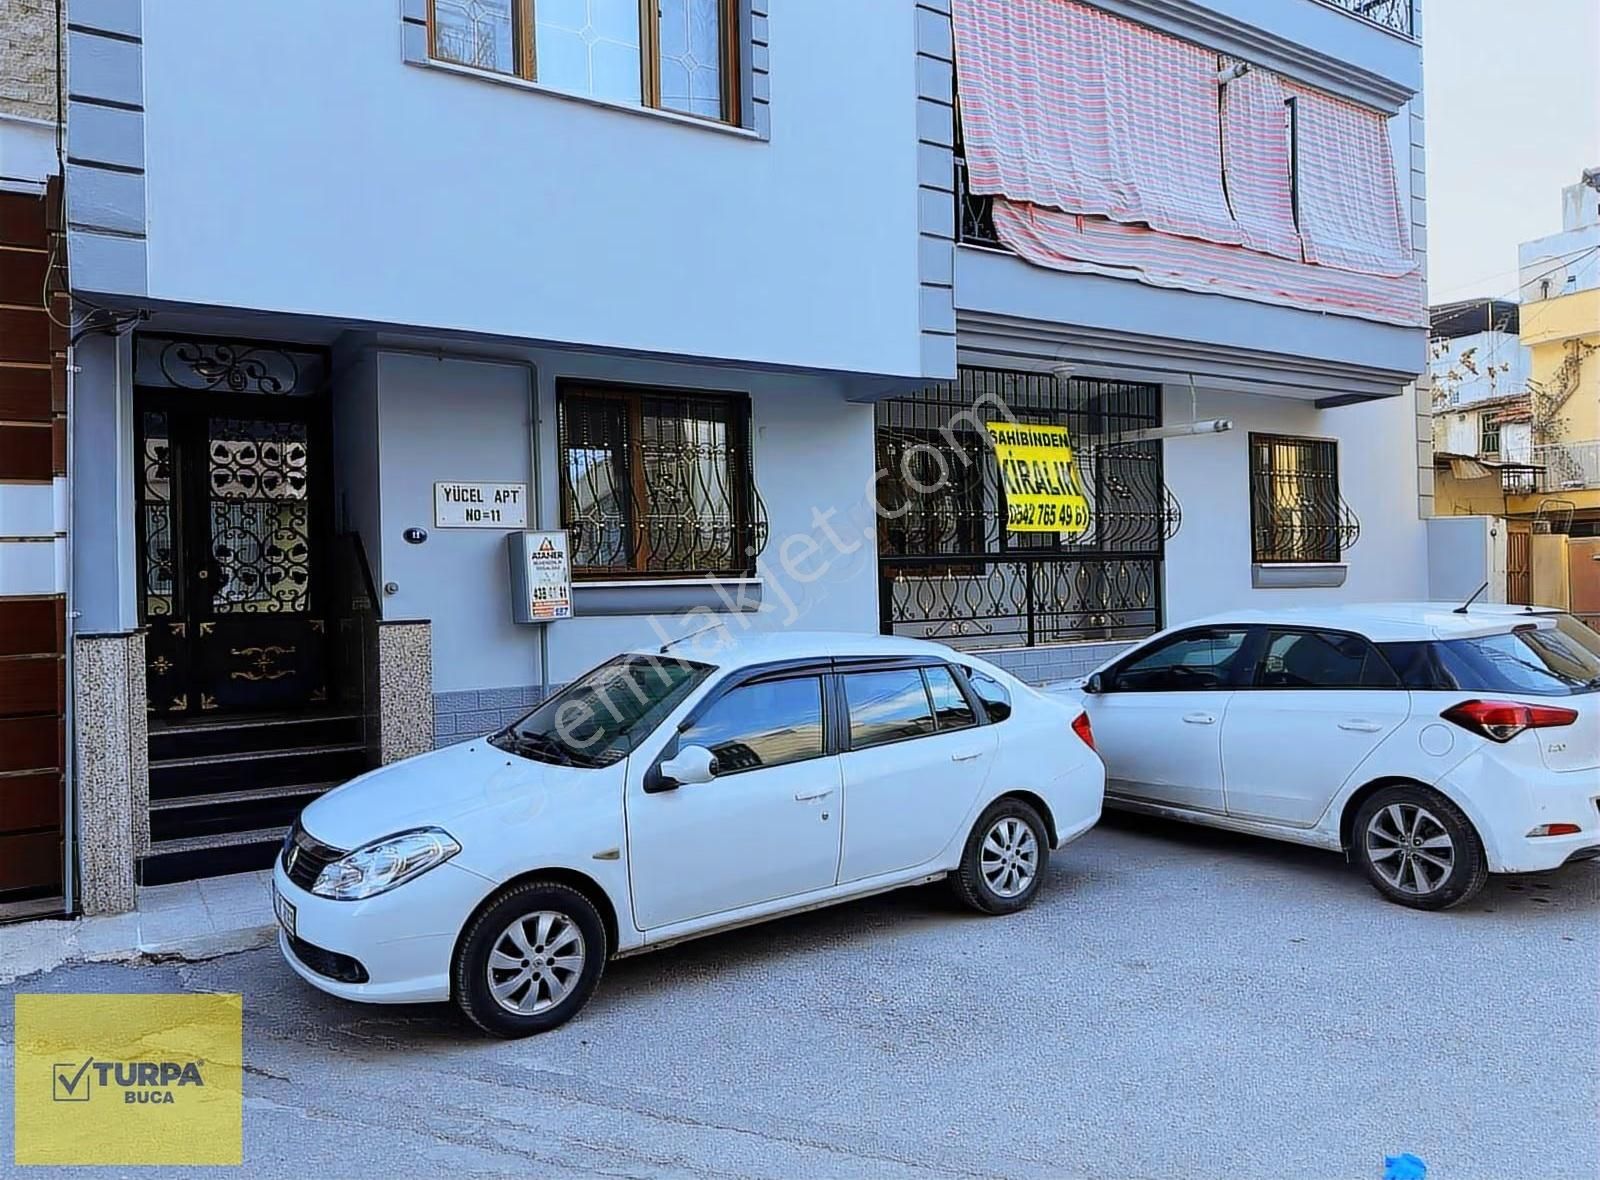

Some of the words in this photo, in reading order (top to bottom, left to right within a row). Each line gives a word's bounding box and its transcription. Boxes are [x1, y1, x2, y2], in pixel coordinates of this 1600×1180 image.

[989, 428, 1070, 448] SAHİBİNDEN
[443, 485, 484, 503] YÜCEL
[494, 489, 520, 504] APT
[1038, 503, 1057, 526] 765
[1060, 503, 1073, 526] 49
